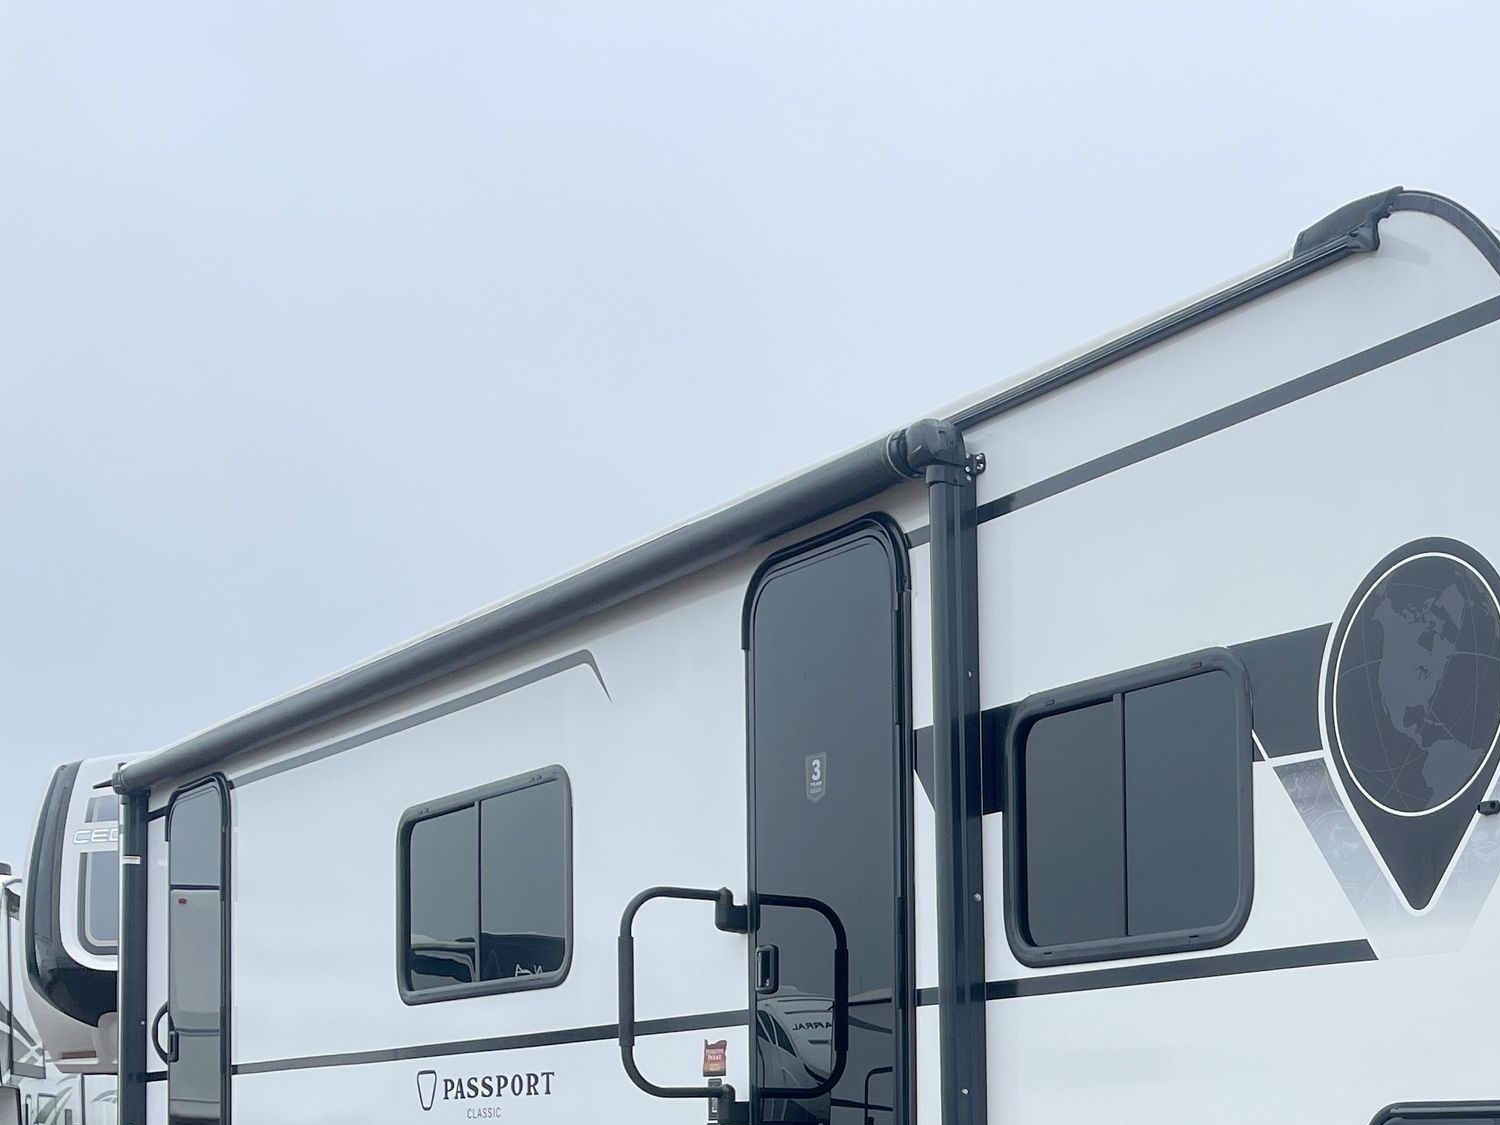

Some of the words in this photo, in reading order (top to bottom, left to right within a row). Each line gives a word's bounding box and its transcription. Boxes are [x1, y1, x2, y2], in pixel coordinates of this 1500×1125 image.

[811, 759, 821, 781] 3
[443, 1072, 555, 1100] PASSPORT
[467, 1107, 501, 1119] CLASSIC
